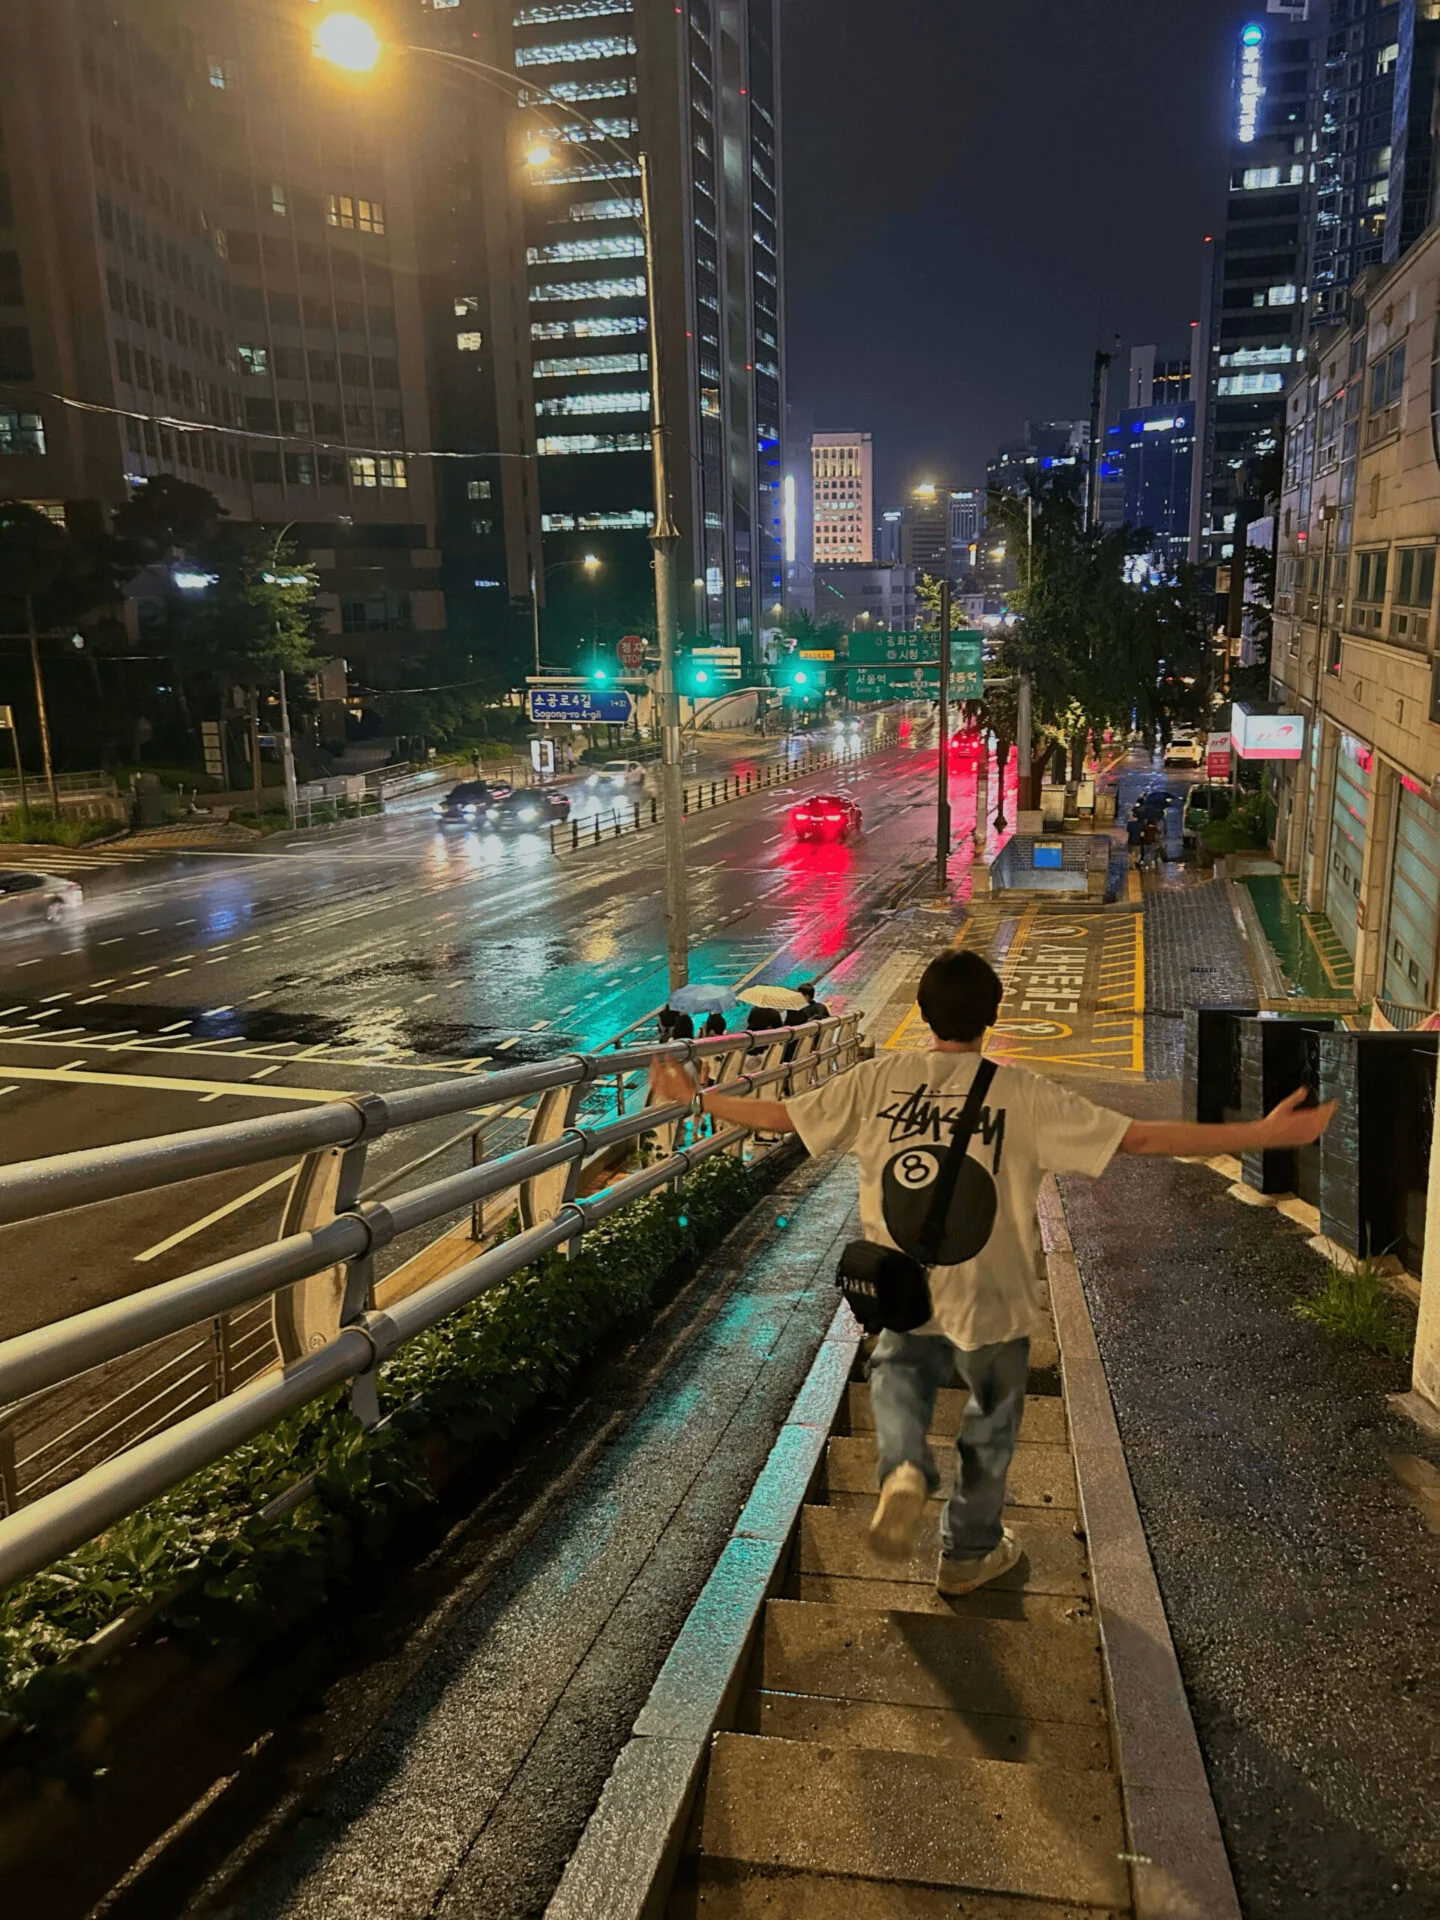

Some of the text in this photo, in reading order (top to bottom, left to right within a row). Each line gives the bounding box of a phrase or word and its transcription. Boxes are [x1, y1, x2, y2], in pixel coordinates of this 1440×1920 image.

[534, 694, 591, 709] 소공로4길
[534, 709, 601, 721] Sogong-ro 4-gil
[901, 1154, 930, 1183] 8
